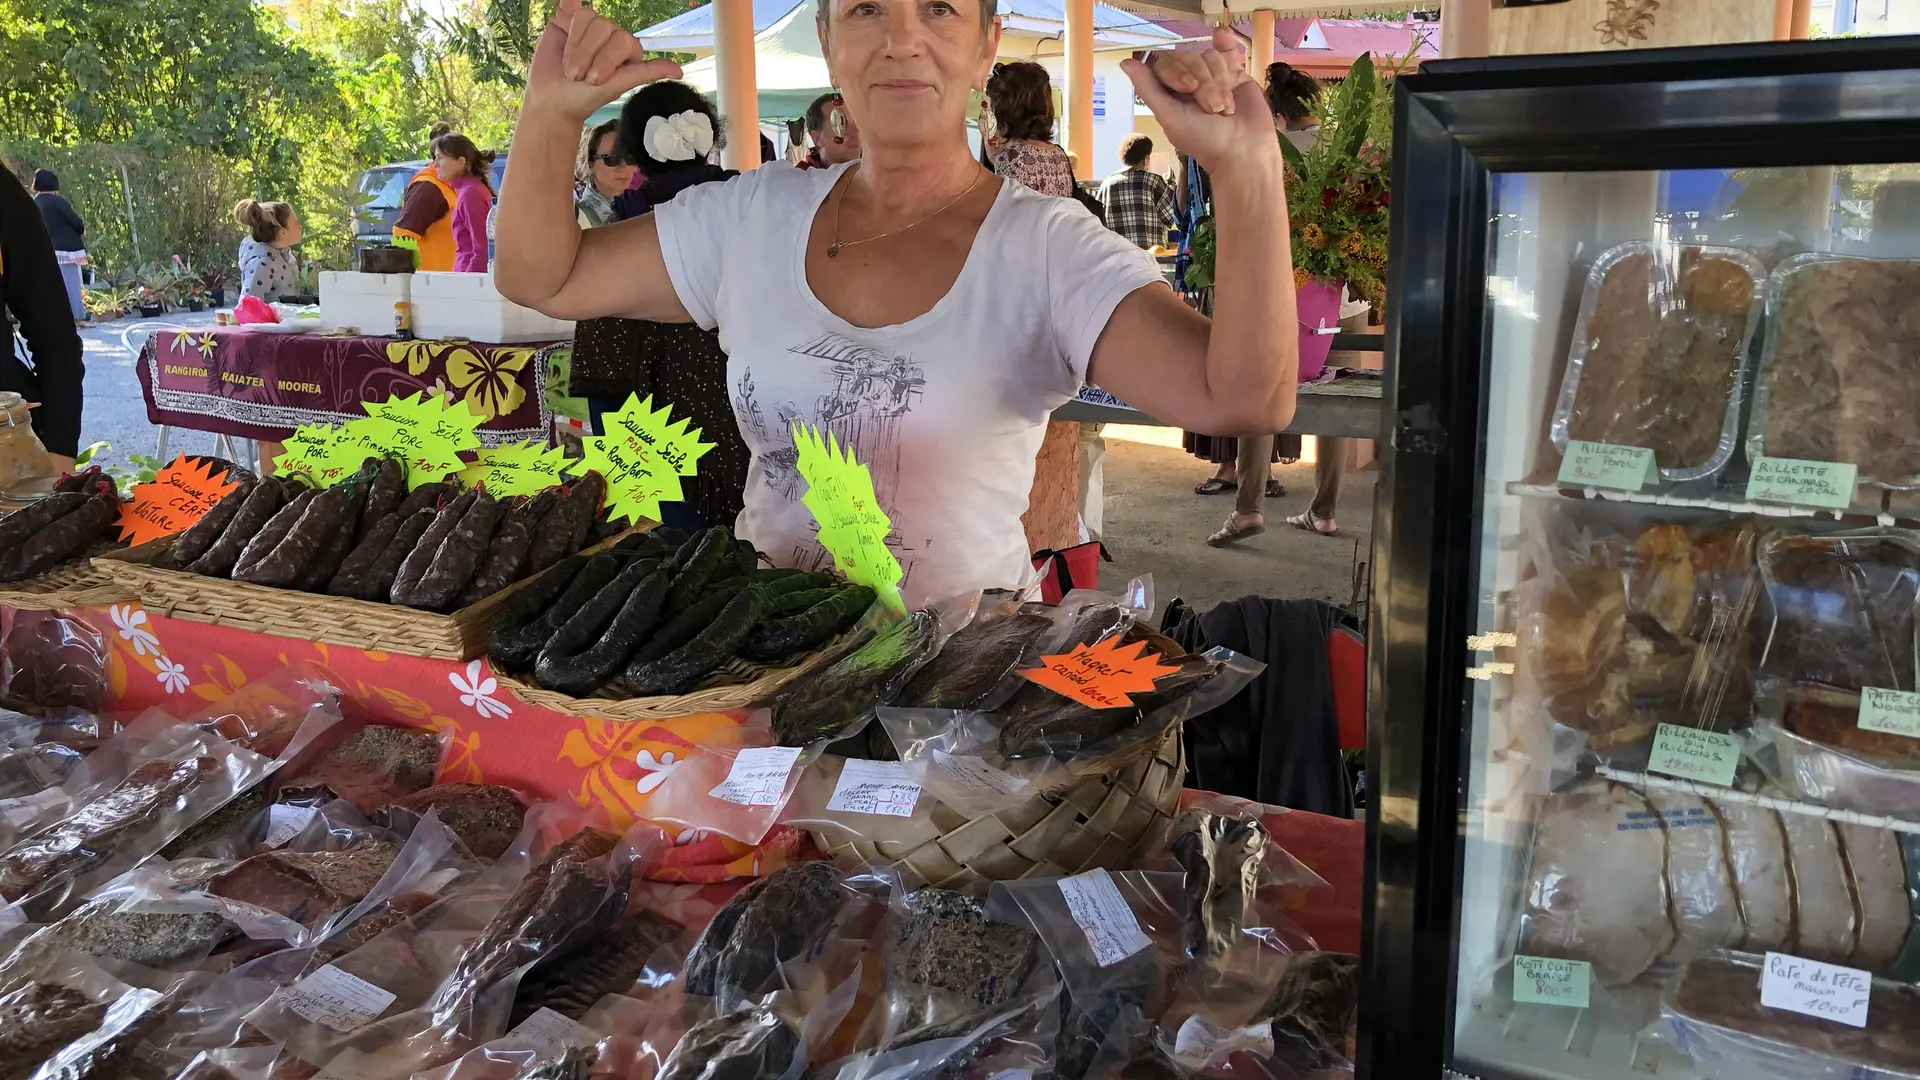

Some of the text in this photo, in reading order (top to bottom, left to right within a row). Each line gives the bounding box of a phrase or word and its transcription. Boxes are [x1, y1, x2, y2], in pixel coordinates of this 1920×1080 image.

[165, 364, 322, 394] RANGIROA RAIATEA MOOREA
[303, 445, 330, 459] PORC
[593, 439, 606, 453] au
[622, 435, 650, 464] PORC
[1581, 443, 1648, 458] RILLETTE
[1758, 462, 1829, 476] RILLETTE
[168, 497, 208, 518] CERF
[1809, 968, 1828, 982] de
